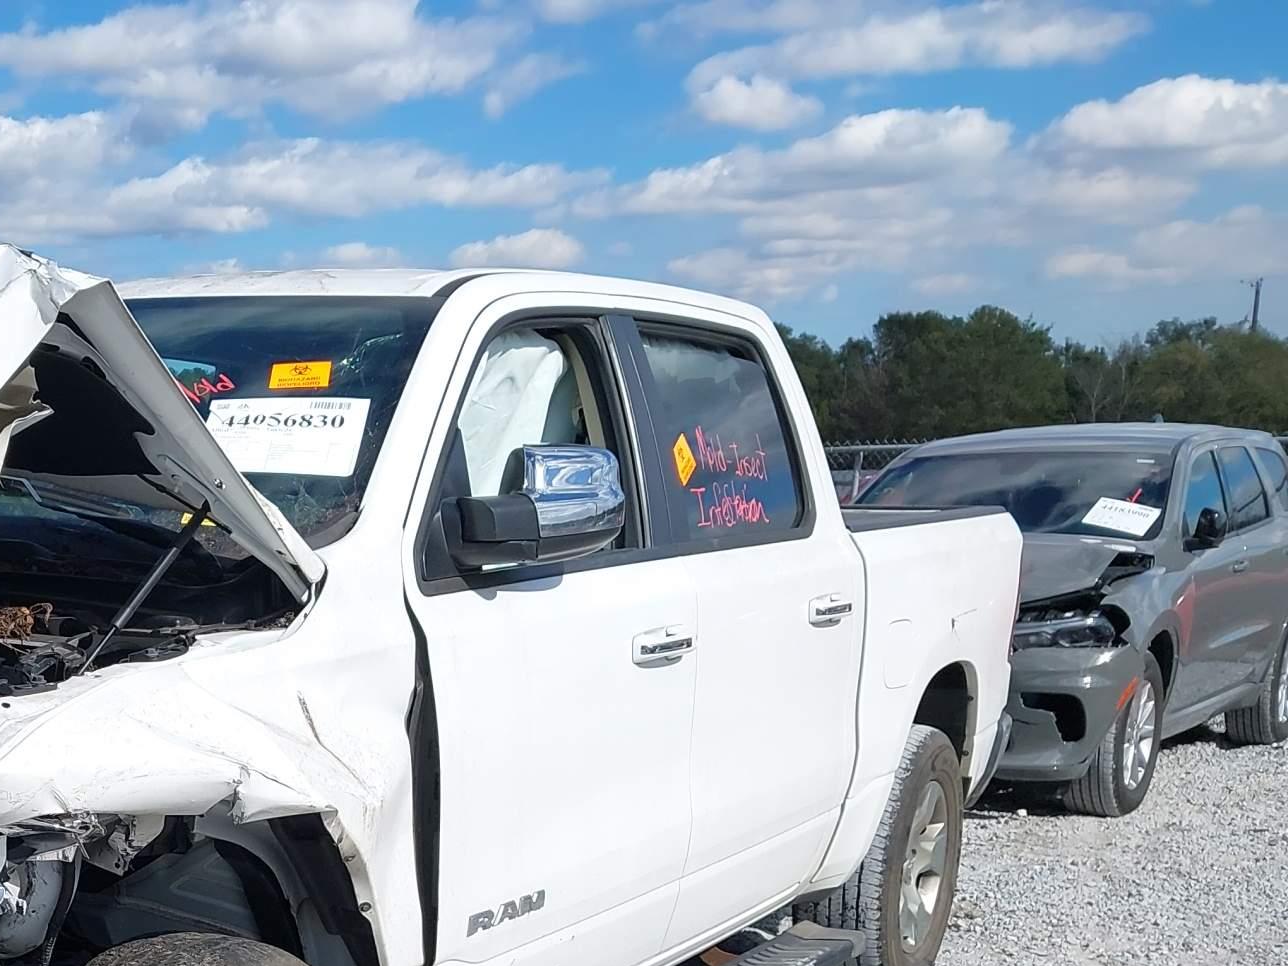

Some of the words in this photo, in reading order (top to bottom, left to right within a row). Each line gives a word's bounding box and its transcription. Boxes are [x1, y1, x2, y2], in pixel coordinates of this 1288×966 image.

[178, 373, 235, 404] old
[221, 412, 345, 428] 44056830
[466, 889, 545, 937] RAM
